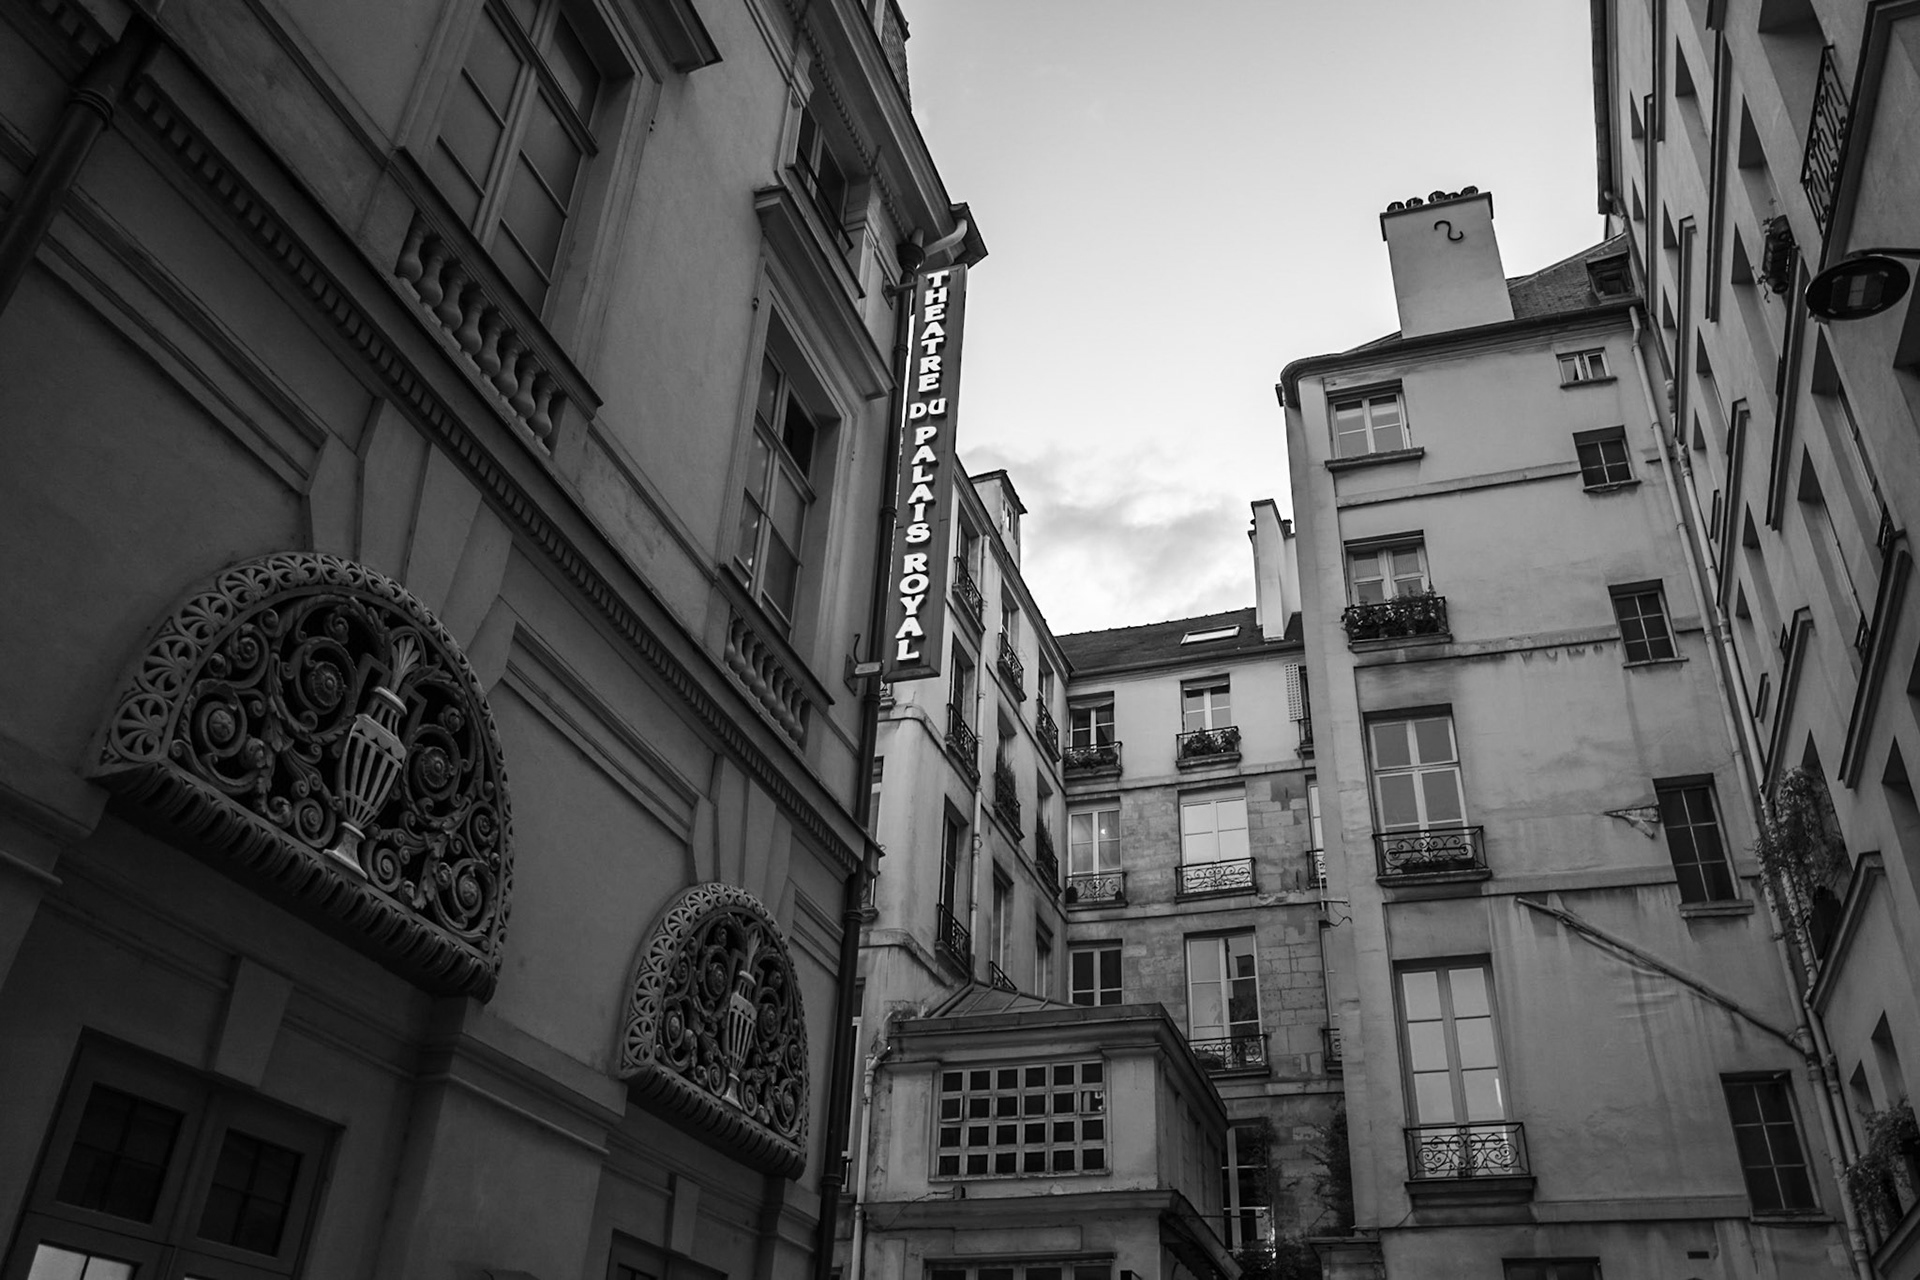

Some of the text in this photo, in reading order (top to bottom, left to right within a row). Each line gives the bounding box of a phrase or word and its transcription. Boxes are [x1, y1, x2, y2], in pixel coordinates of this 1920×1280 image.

[895, 270, 950, 661] THEATRE DU PALAIS ROYAL
